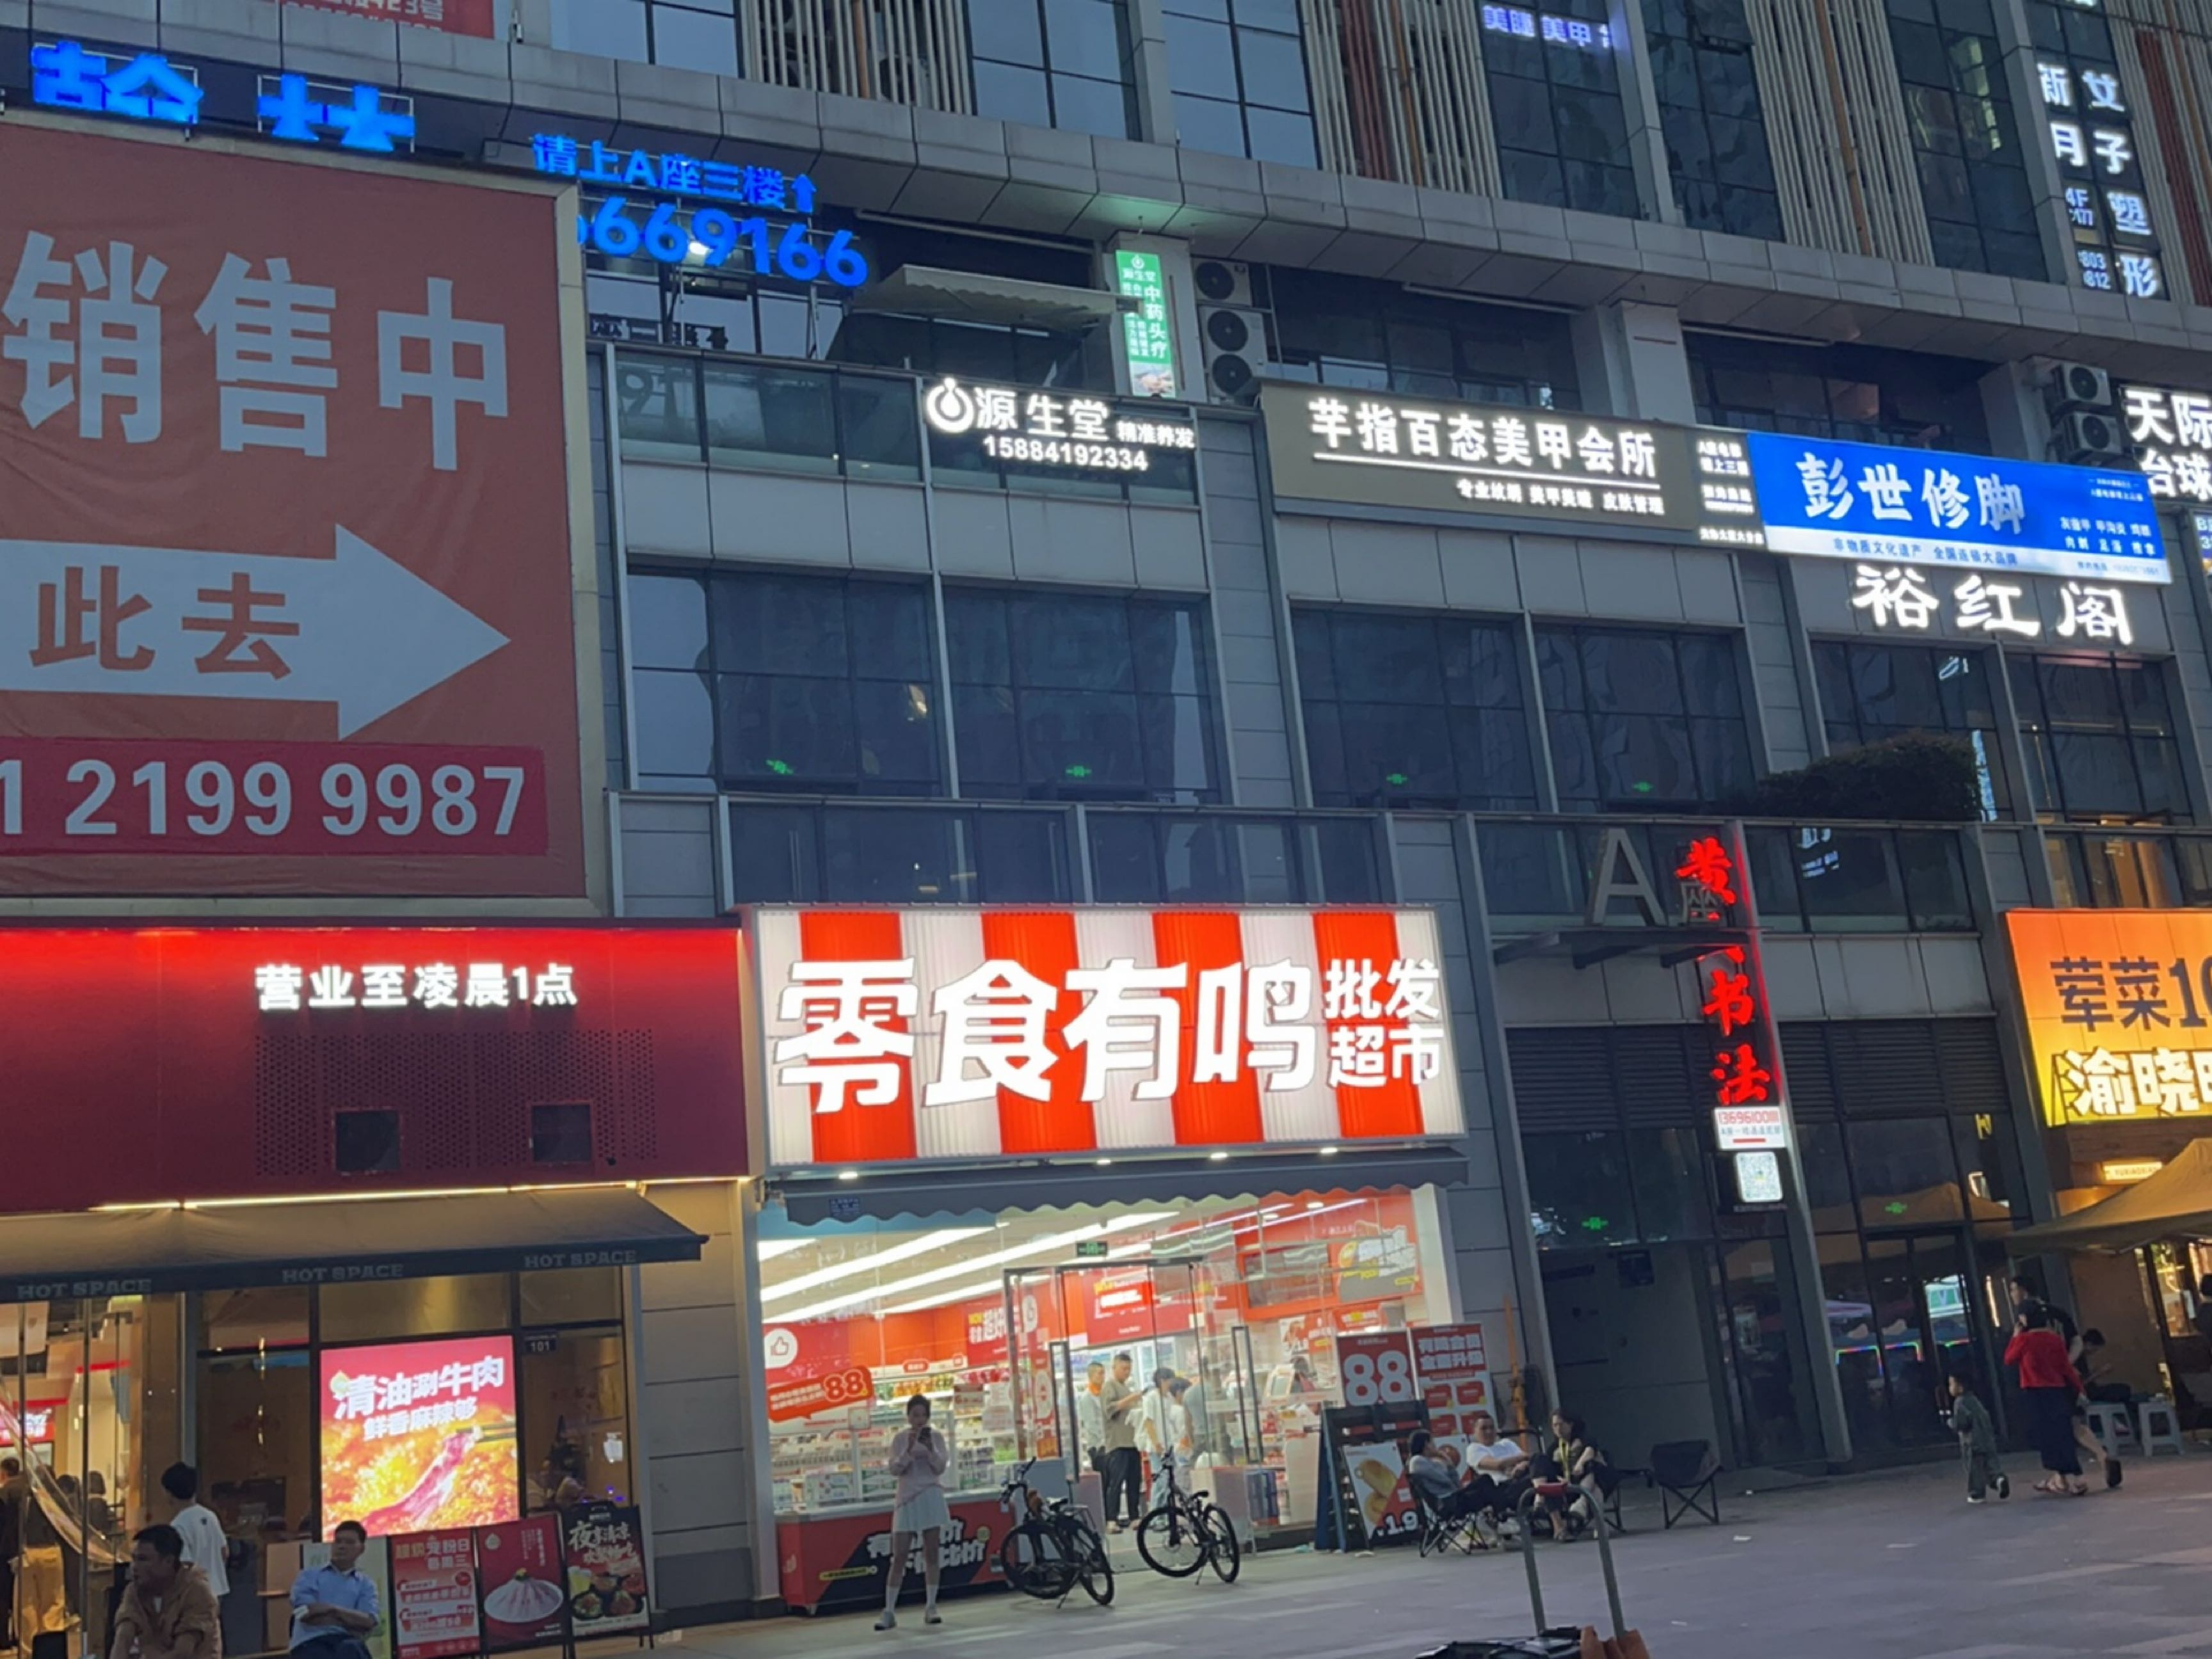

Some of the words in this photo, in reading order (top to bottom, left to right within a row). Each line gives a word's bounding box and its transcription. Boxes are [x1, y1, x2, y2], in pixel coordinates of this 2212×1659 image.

[533, 133, 785, 209] 请上A座三楼
[2083, 69, 2160, 298] 女子塑形
[577, 196, 868, 287] 669166
[2, 230, 509, 472] 销售中
[1144, 285, 1167, 359] 中药头疗
[975, 387, 1109, 442] 源生堂
[1116, 420, 1195, 449] 精准养发
[2125, 387, 2212, 448] 天际
[983, 435, 1148, 471] 15884192334
[2141, 447, 2212, 502] 台球
[1796, 452, 2026, 536] 彭世修脚
[1834, 538, 1921, 558] 非物质文化遗产
[1934, 547, 2017, 565] 全国连锁大品牌
[29, 565, 300, 680] 此去
[1853, 566, 2133, 645] 裕红阁
[65, 760, 292, 836] 2199
[320, 764, 525, 836] 9987
[255, 963, 577, 1011] 营业至凌晨1点
[1324, 958, 1441, 1020] 批发
[774, 958, 1316, 1114] 零食有鸣
[1328, 1024, 1445, 1089] 超市
[18, 1285, 67, 1299] HOT
[73, 1279, 152, 1296] SPACE
[282, 1268, 328, 1283] HOT
[333, 1264, 404, 1280] SPACE
[524, 1254, 572, 1269] HOT
[576, 1250, 637, 1267] SPACE
[333, 1355, 504, 1420] 清油涮牛肉
[824, 1368, 868, 1403] 88
[1344, 1350, 1411, 1406] 88
